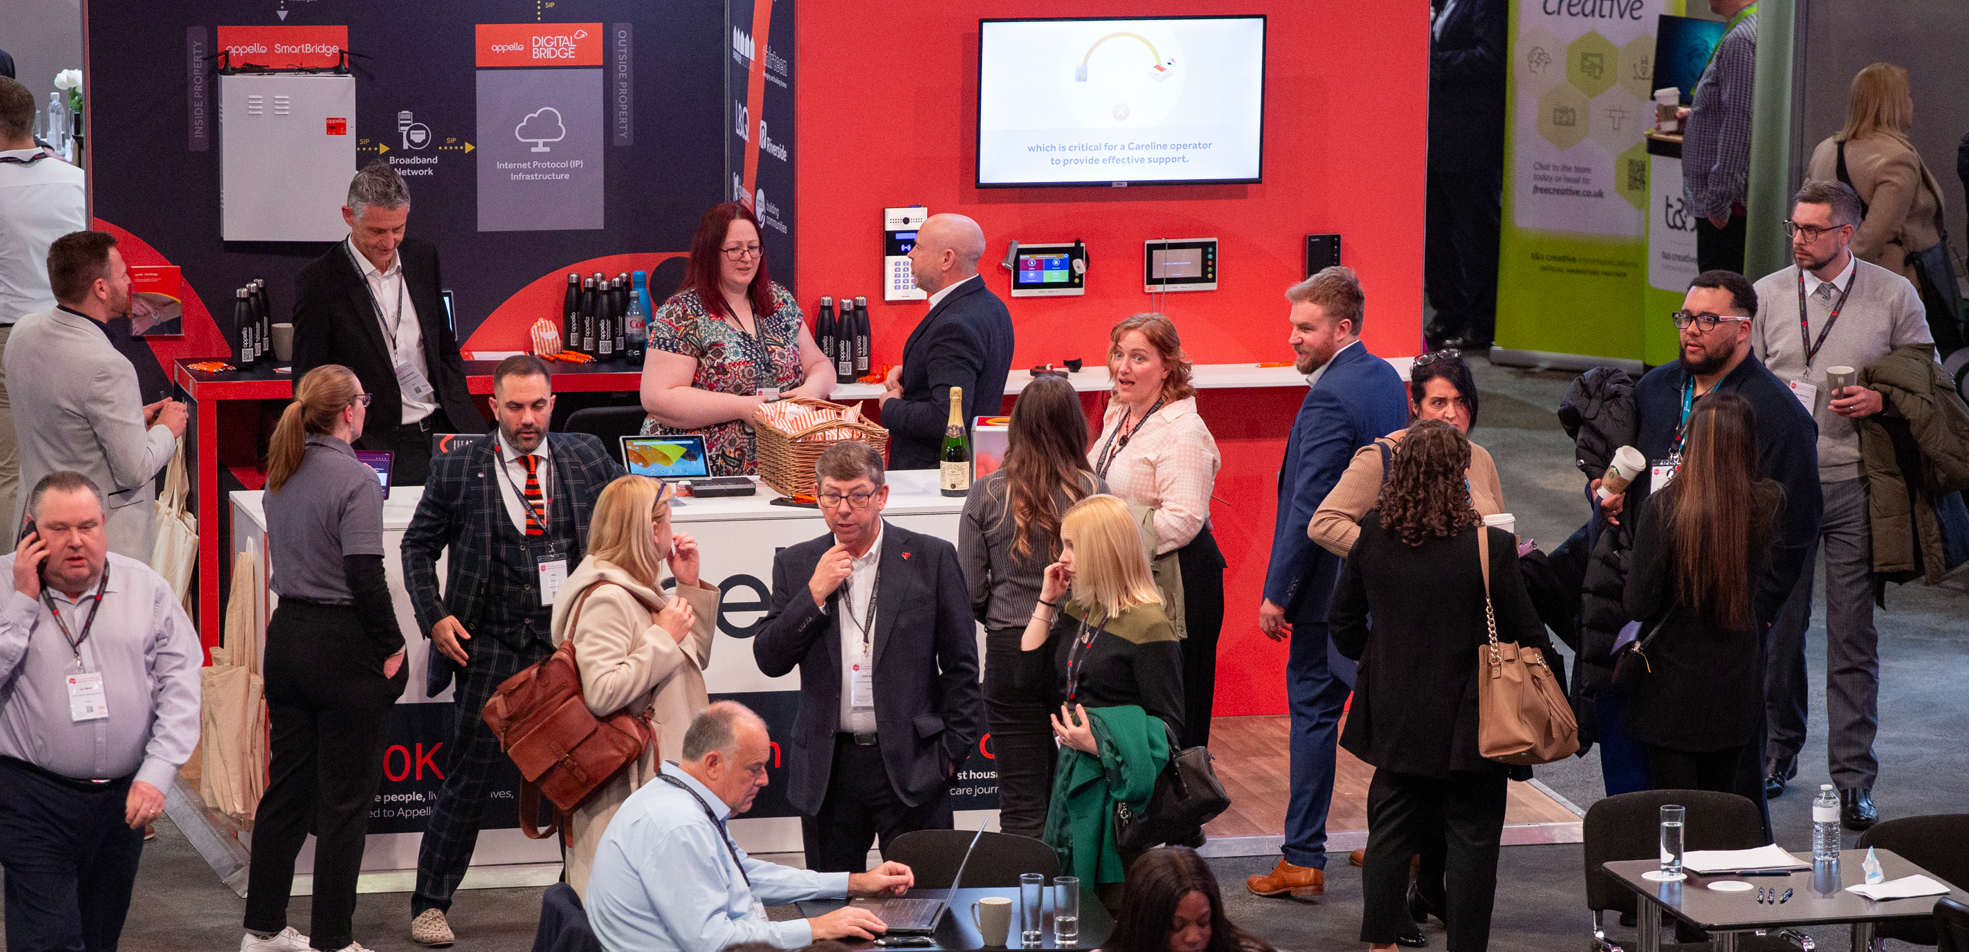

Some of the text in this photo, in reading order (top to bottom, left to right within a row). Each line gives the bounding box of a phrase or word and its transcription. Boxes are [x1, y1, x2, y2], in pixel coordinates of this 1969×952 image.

[532, 36, 577, 47] DIGITAL
[226, 43, 339, 57] appello SmartBridge
[491, 43, 524, 53] appello
[532, 48, 576, 59] BRIDGE
[193, 40, 204, 137] INSIDE PROPERTY
[618, 30, 628, 138] OUTSIDE PROPERTY
[1028, 143, 1057, 152] which
[1058, 143, 1066, 152] is
[1068, 143, 1102, 152] critical
[1103, 142, 1118, 151] for
[1127, 142, 1168, 151] Careline
[1170, 141, 1213, 153] operator
[389, 156, 438, 165] Broadband
[497, 159, 584, 169] Internet Protocol (IP)
[1050, 154, 1189, 167] to provide effective support.
[395, 167, 434, 176] Network
[510, 172, 570, 180] Infrastructure
[957, 770, 967, 780] st
[383, 791, 426, 804] people,
[383, 809, 395, 818] to
[397, 806, 433, 819] Appell
